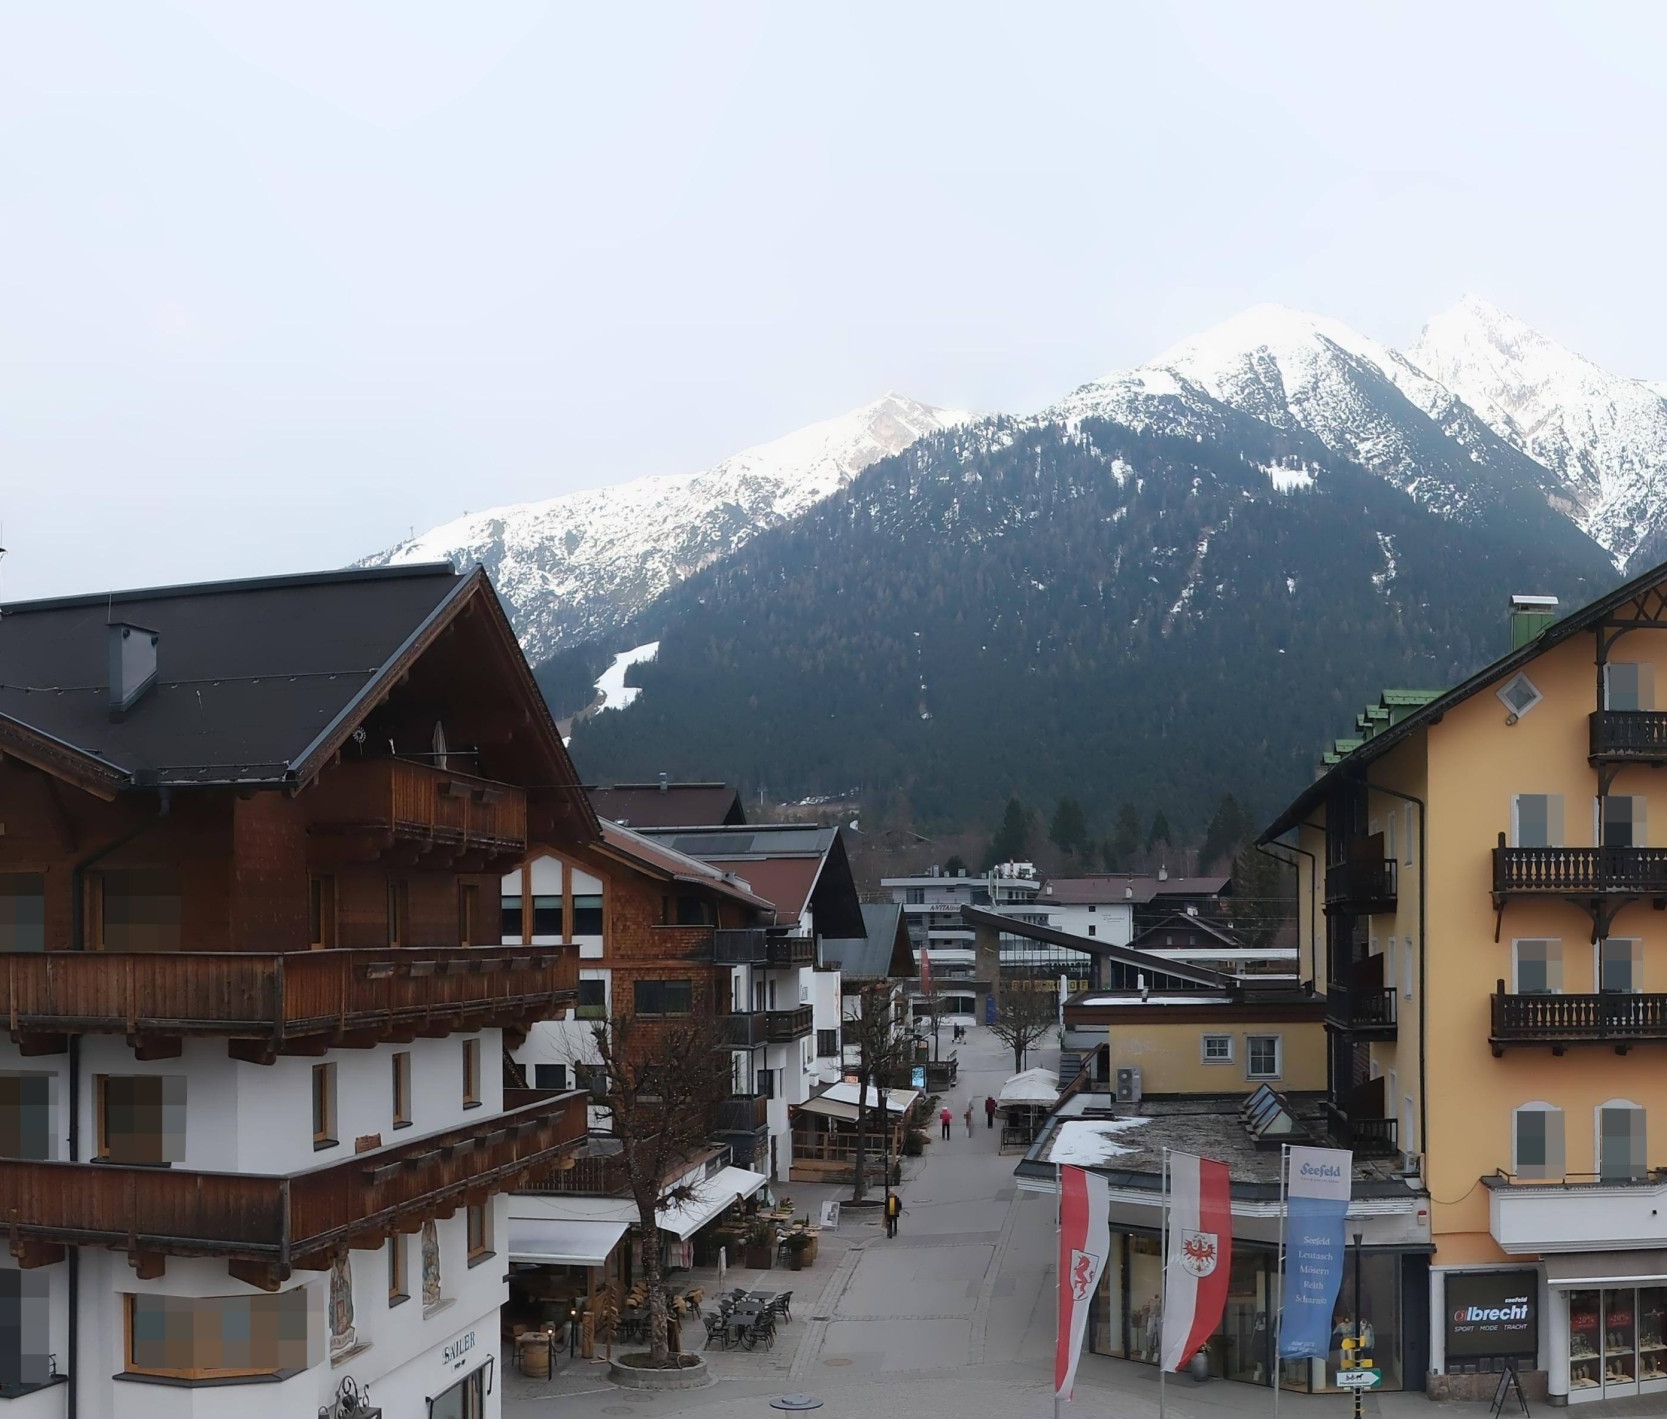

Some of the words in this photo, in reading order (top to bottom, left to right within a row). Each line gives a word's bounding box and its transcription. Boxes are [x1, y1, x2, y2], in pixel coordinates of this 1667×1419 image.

[1300, 1162, 1341, 1177] Seefeld
[1298, 1250, 1333, 1261] Leutasch
[1300, 1265, 1330, 1275] Mösern
[1303, 1280, 1324, 1290] Reith
[1504, 1323, 1528, 1331] TRACHT
